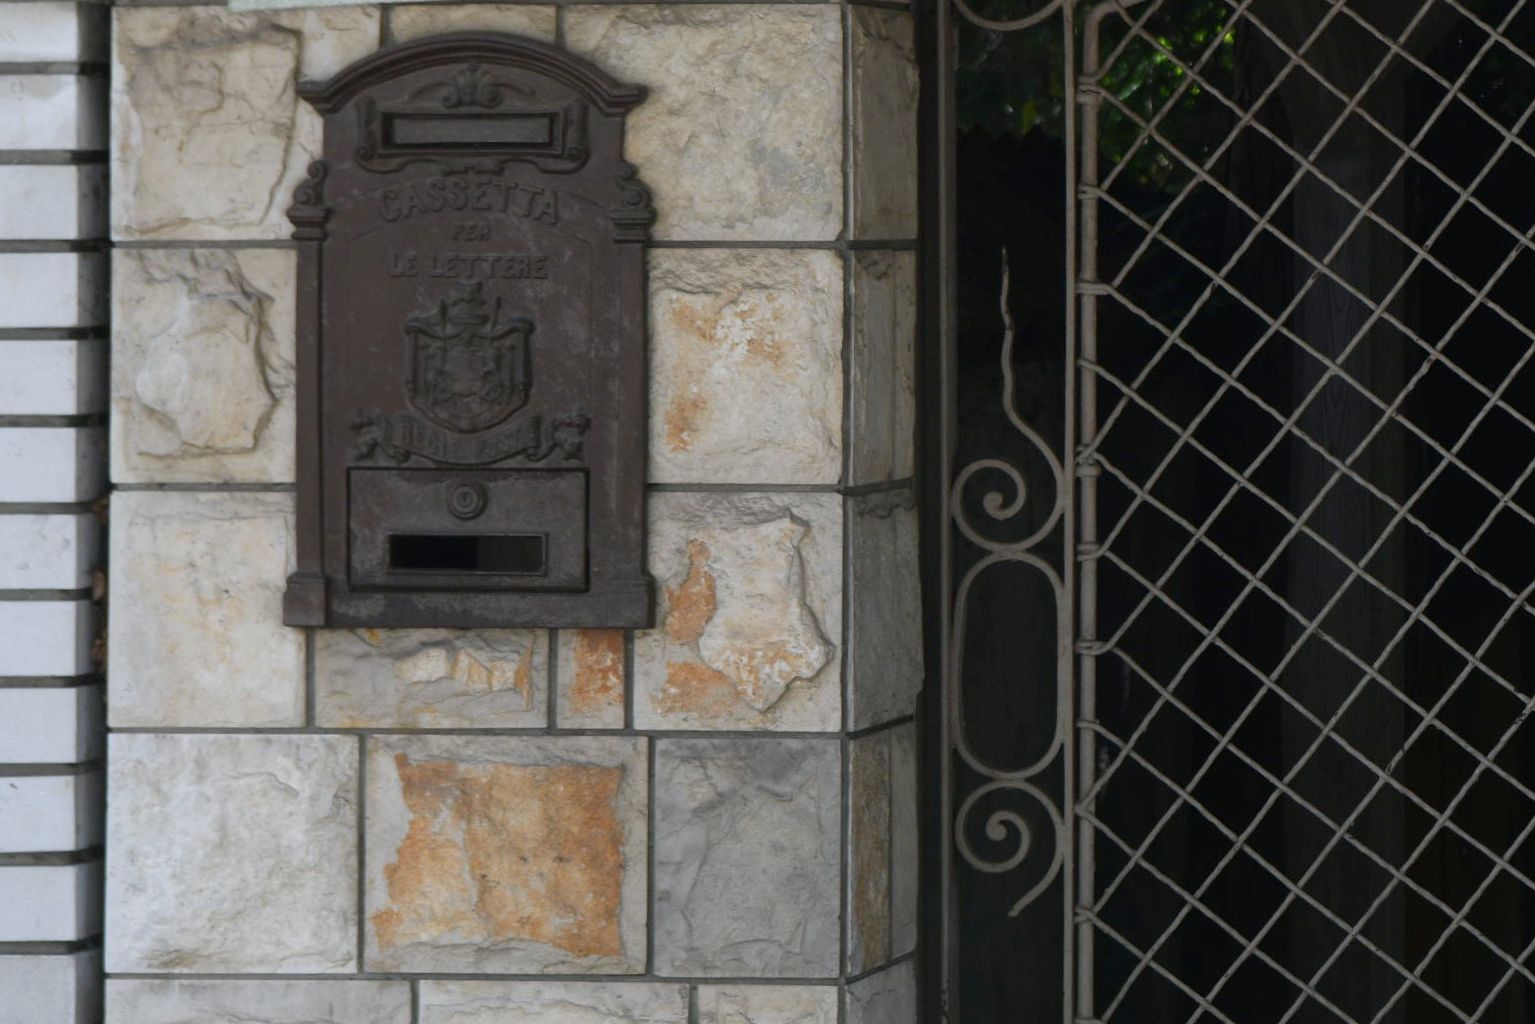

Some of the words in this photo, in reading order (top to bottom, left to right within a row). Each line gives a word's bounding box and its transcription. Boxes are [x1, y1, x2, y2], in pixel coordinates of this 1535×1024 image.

[381, 179, 558, 224] CASSETTA
[452, 225, 491, 241] PER
[391, 253, 418, 278] LE
[431, 253, 548, 279] LETTERE
